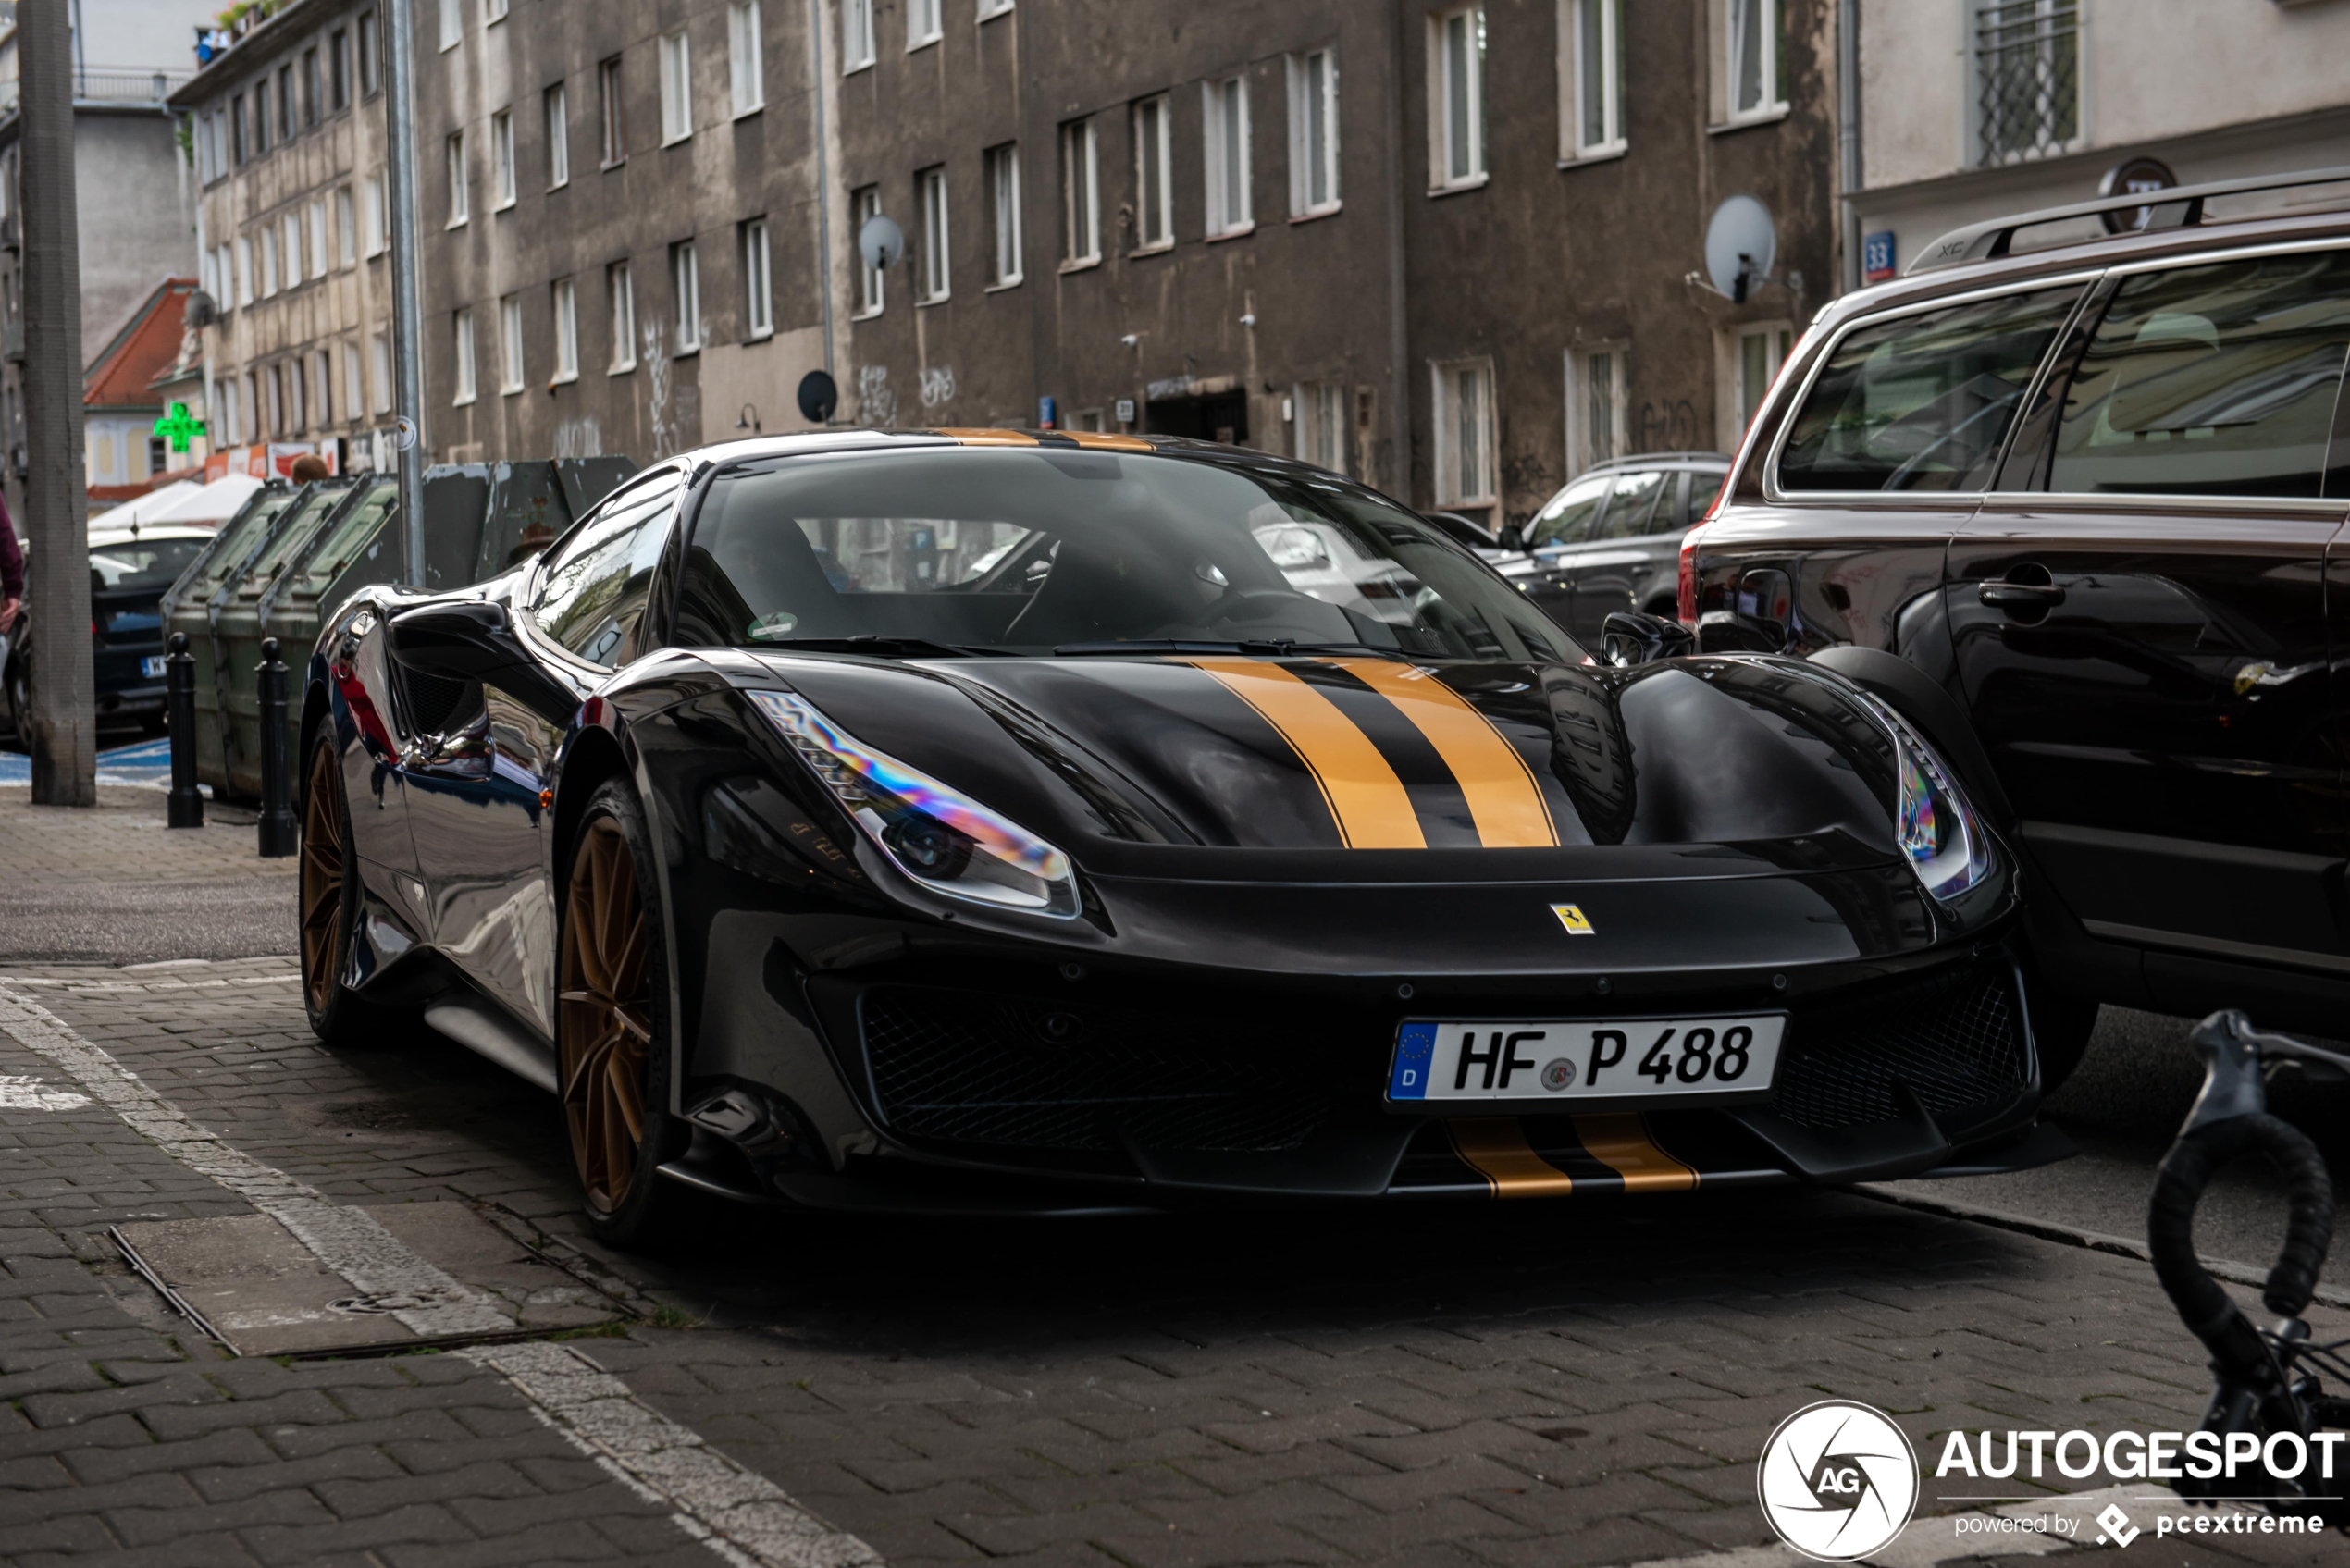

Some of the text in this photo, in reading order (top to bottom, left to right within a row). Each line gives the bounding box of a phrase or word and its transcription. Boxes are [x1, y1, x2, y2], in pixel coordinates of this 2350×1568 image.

[1868, 241, 1888, 270] 33
[1937, 241, 1964, 258] XC
[1454, 1031, 1546, 1090] HF
[1586, 1029, 1626, 1086] P
[1637, 1026, 1753, 1084] 488
[1402, 1069, 1416, 1086] D
